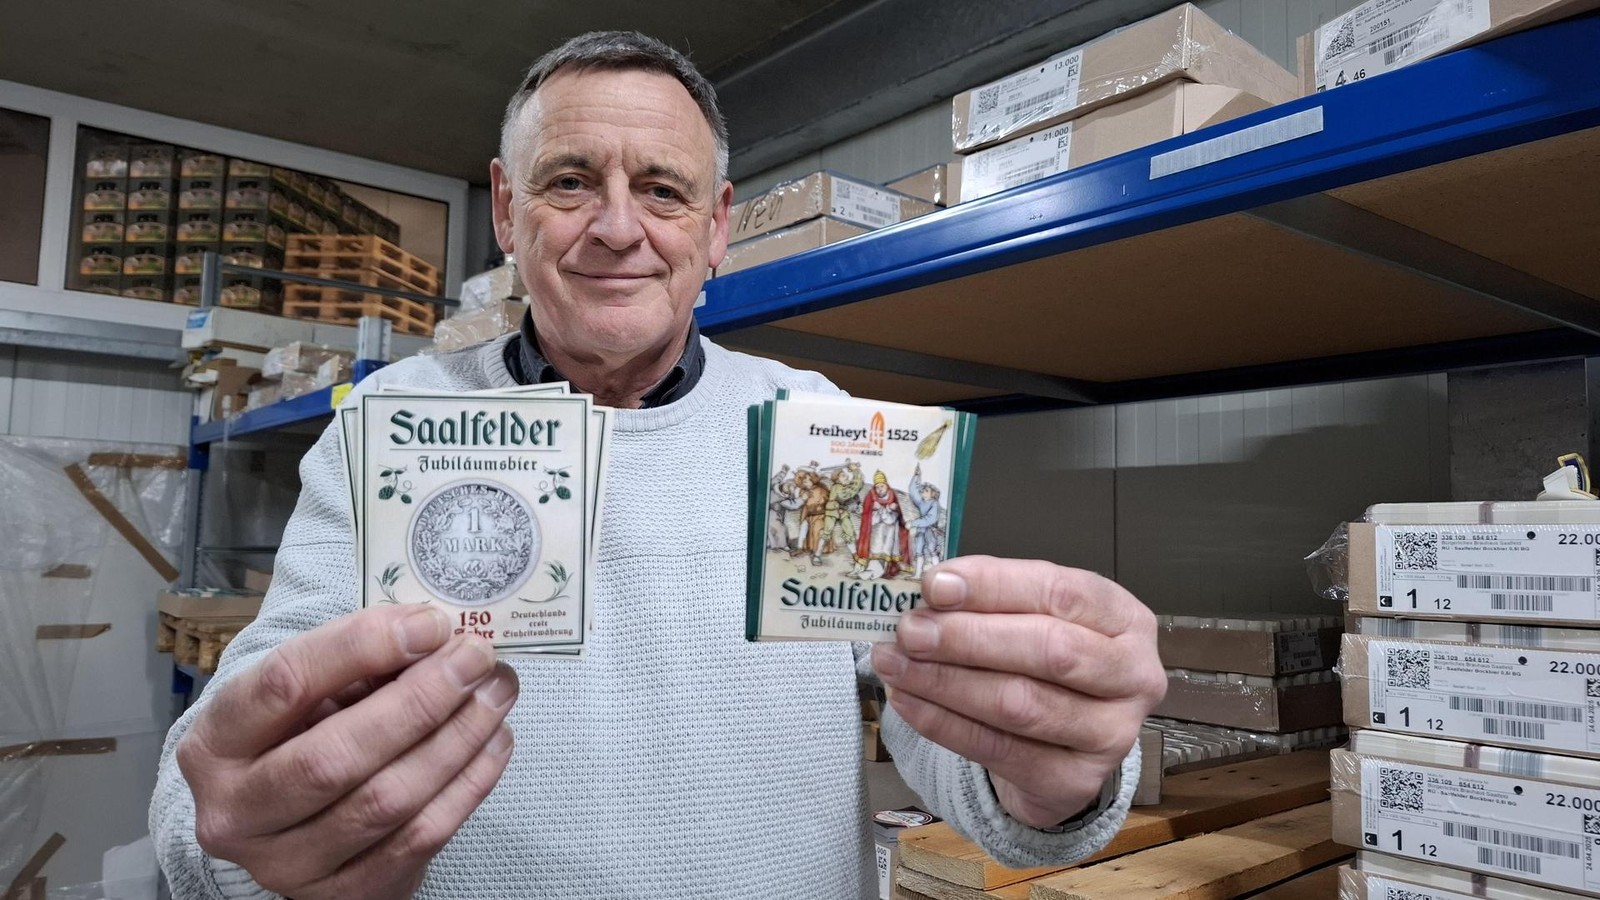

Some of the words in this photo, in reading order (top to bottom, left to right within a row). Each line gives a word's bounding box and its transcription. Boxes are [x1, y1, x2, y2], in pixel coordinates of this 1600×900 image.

[1054, 55, 1079, 70] 13.000
[1354, 69, 1365, 80] 46
[1043, 127, 1068, 141] 21.000
[840, 206, 845, 215] 2
[390, 409, 562, 446] Saalfelder
[809, 424, 867, 441] freiheyt
[887, 429, 918, 441] 1525
[417, 455, 538, 473] Jubiläumsbier
[469, 506, 481, 533] 1
[443, 537, 503, 552] MARK
[781, 578, 921, 613] Saalfelder
[1407, 589, 1416, 608] 1
[1434, 598, 1451, 610] 12
[459, 610, 491, 627] 150
[511, 610, 567, 619] Deutschlands
[454, 626, 494, 639] Jhre
[1550, 661, 1600, 675] 22.00
[1400, 707, 1409, 727] 1
[1427, 718, 1443, 730] 12
[1392, 830, 1402, 850] 1
[1420, 844, 1437, 857] 12
